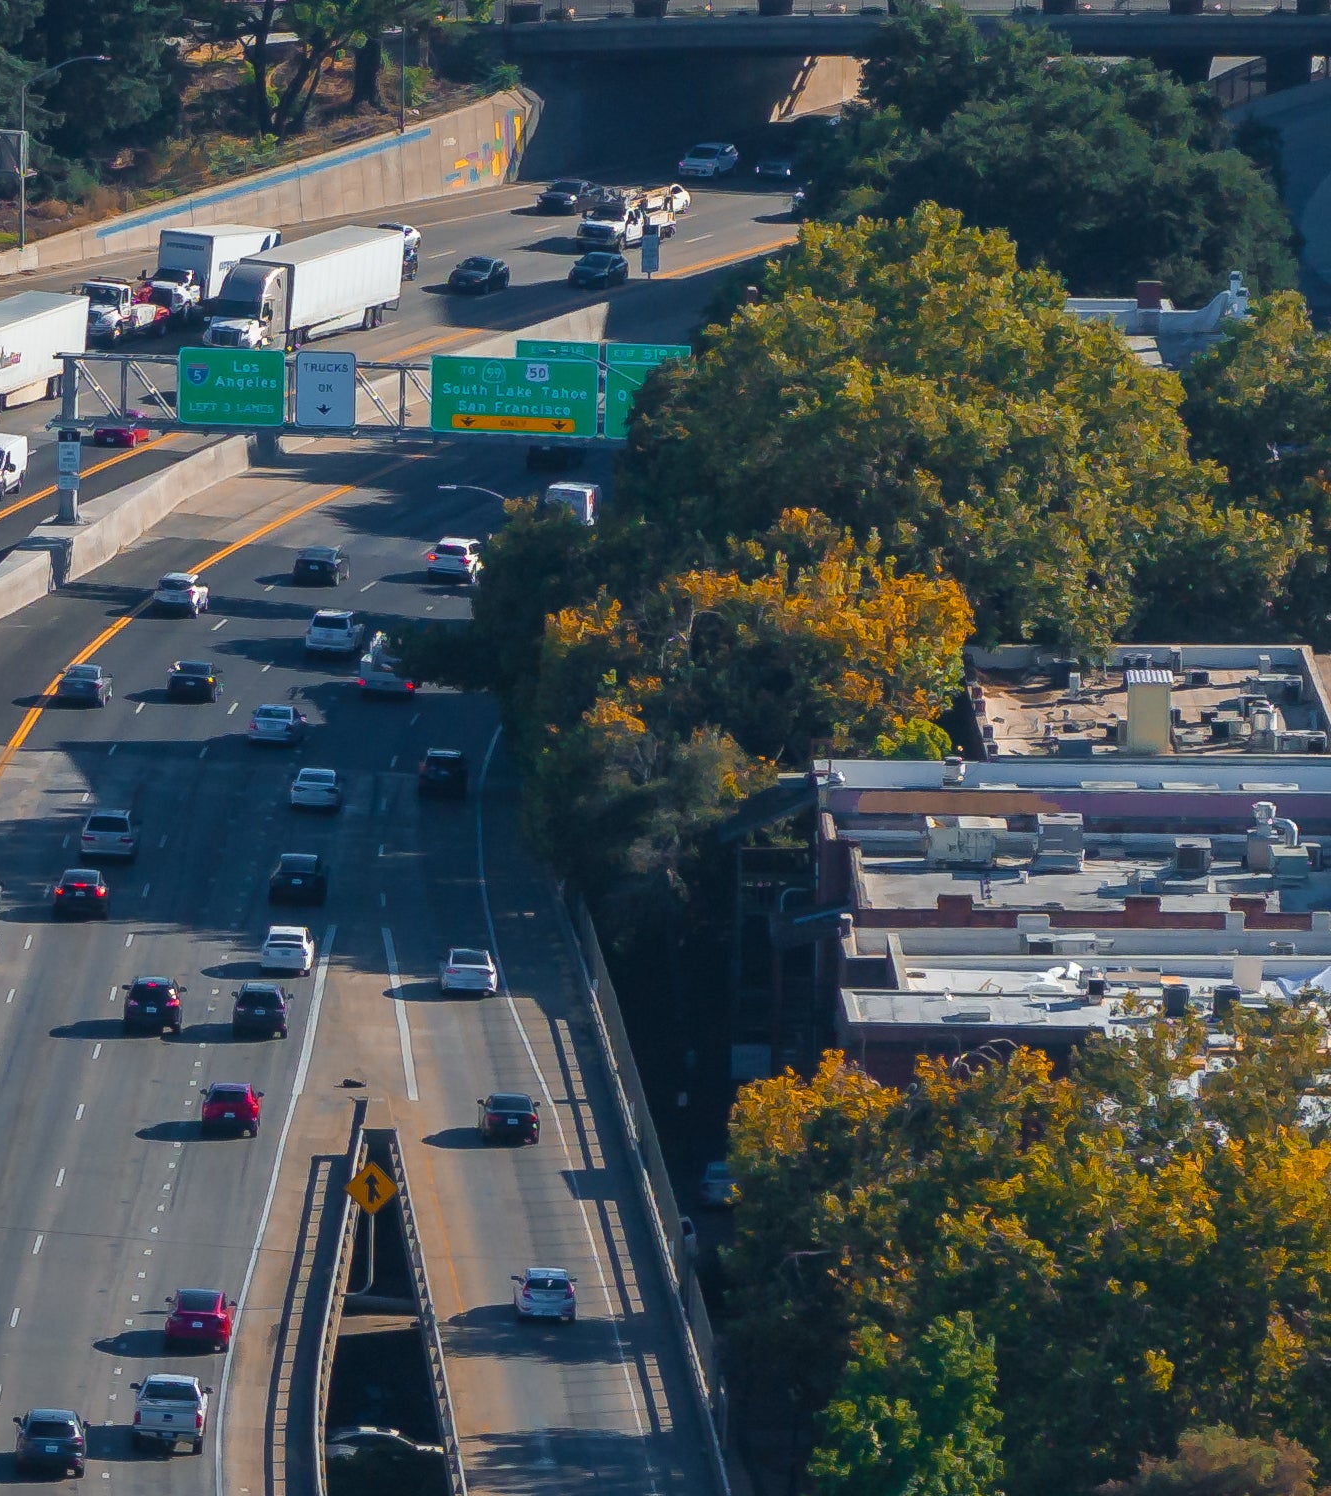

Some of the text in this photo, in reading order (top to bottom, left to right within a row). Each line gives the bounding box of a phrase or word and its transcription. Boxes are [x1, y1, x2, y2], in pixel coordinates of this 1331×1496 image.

[232, 360, 260, 373] Los
[303, 363, 349, 373] TRUCKS
[459, 366, 547, 379] TO 99 50
[193, 369, 202, 381] 5
[214, 375, 277, 391] Angeles
[318, 383, 334, 393] OK
[442, 382, 588, 400] South Lake Tahoe
[188, 402, 275, 414] LEFT 3 LANES
[457, 400, 571, 416] San Francisco
[499, 419, 527, 428] ONLY
